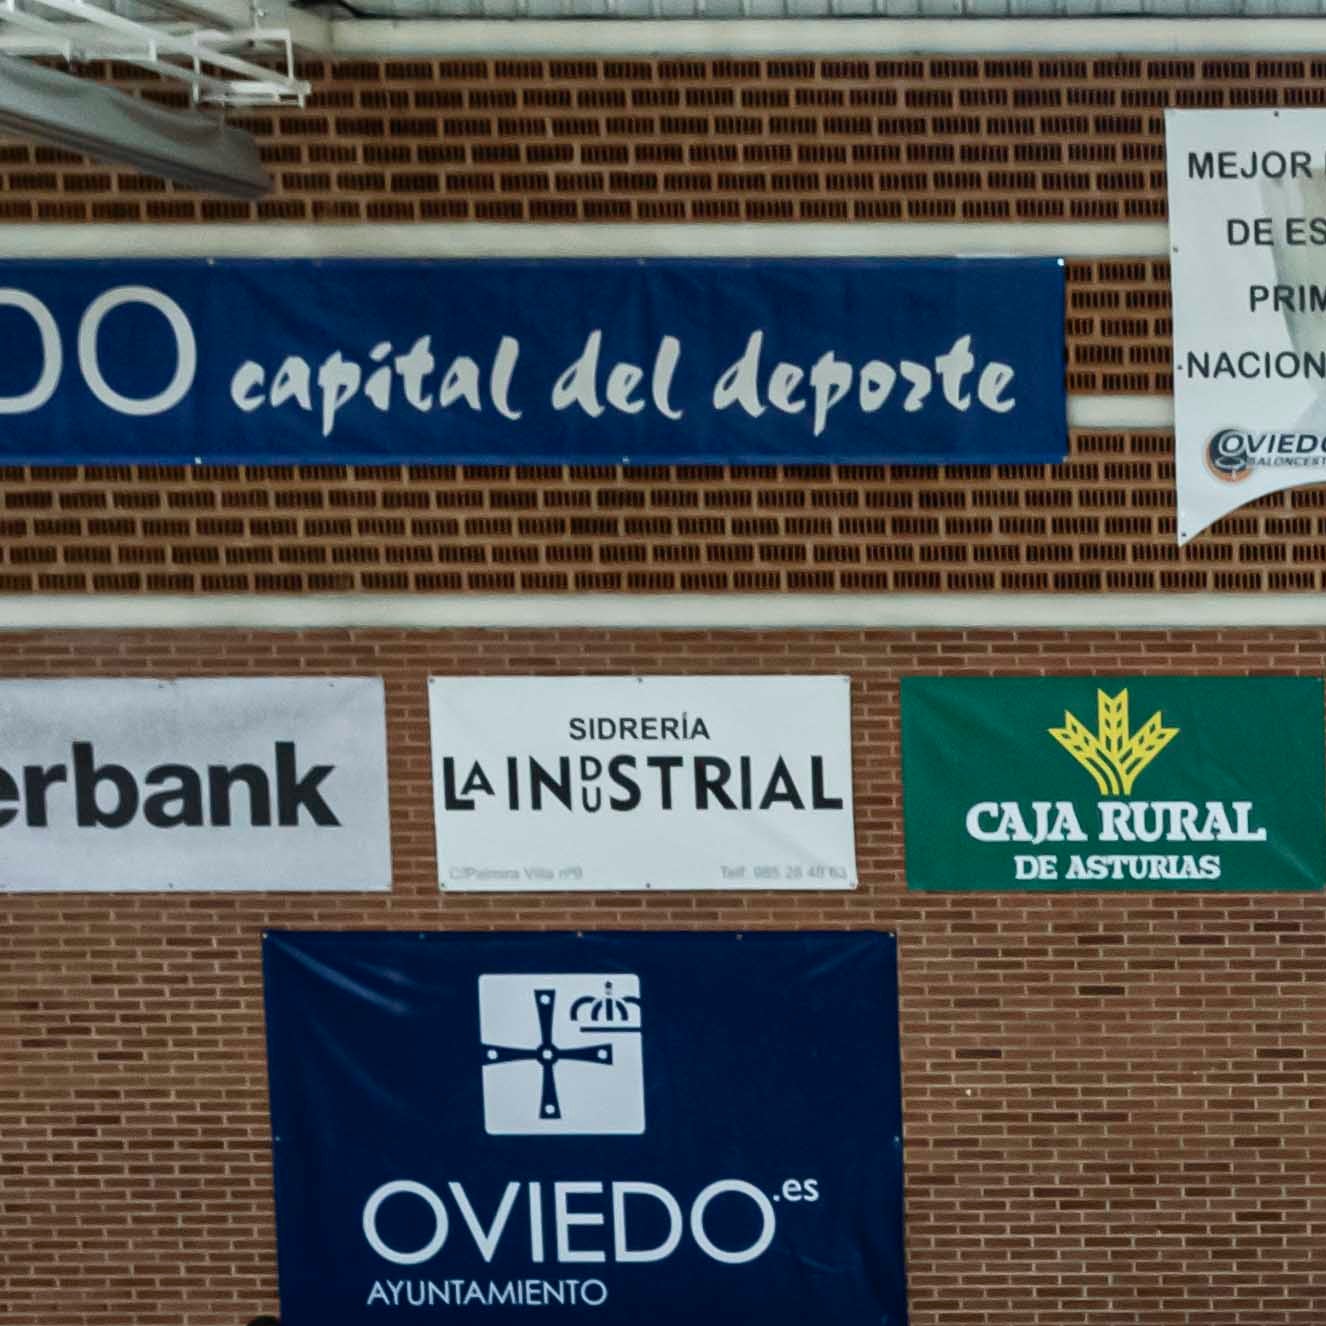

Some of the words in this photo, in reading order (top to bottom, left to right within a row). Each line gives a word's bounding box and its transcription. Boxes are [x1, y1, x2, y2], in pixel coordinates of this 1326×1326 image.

[1188, 151, 1312, 180] MEJOR
[1227, 218, 1274, 246] DE
[230, 335, 523, 436] capital
[551, 329, 684, 422] del
[711, 331, 1017, 436] deporte
[569, 712, 711, 741] SIDRERÍA
[443, 756, 495, 811] LA
[507, 754, 844, 813] INDUSTRIAL
[966, 801, 1088, 844] CAJA
[1098, 801, 1267, 842] RURAL
[1015, 855, 1058, 880] DE
[1065, 855, 1221, 880] ASTURIAS
[366, 1279, 608, 1306] AYUNTAMIENTO
